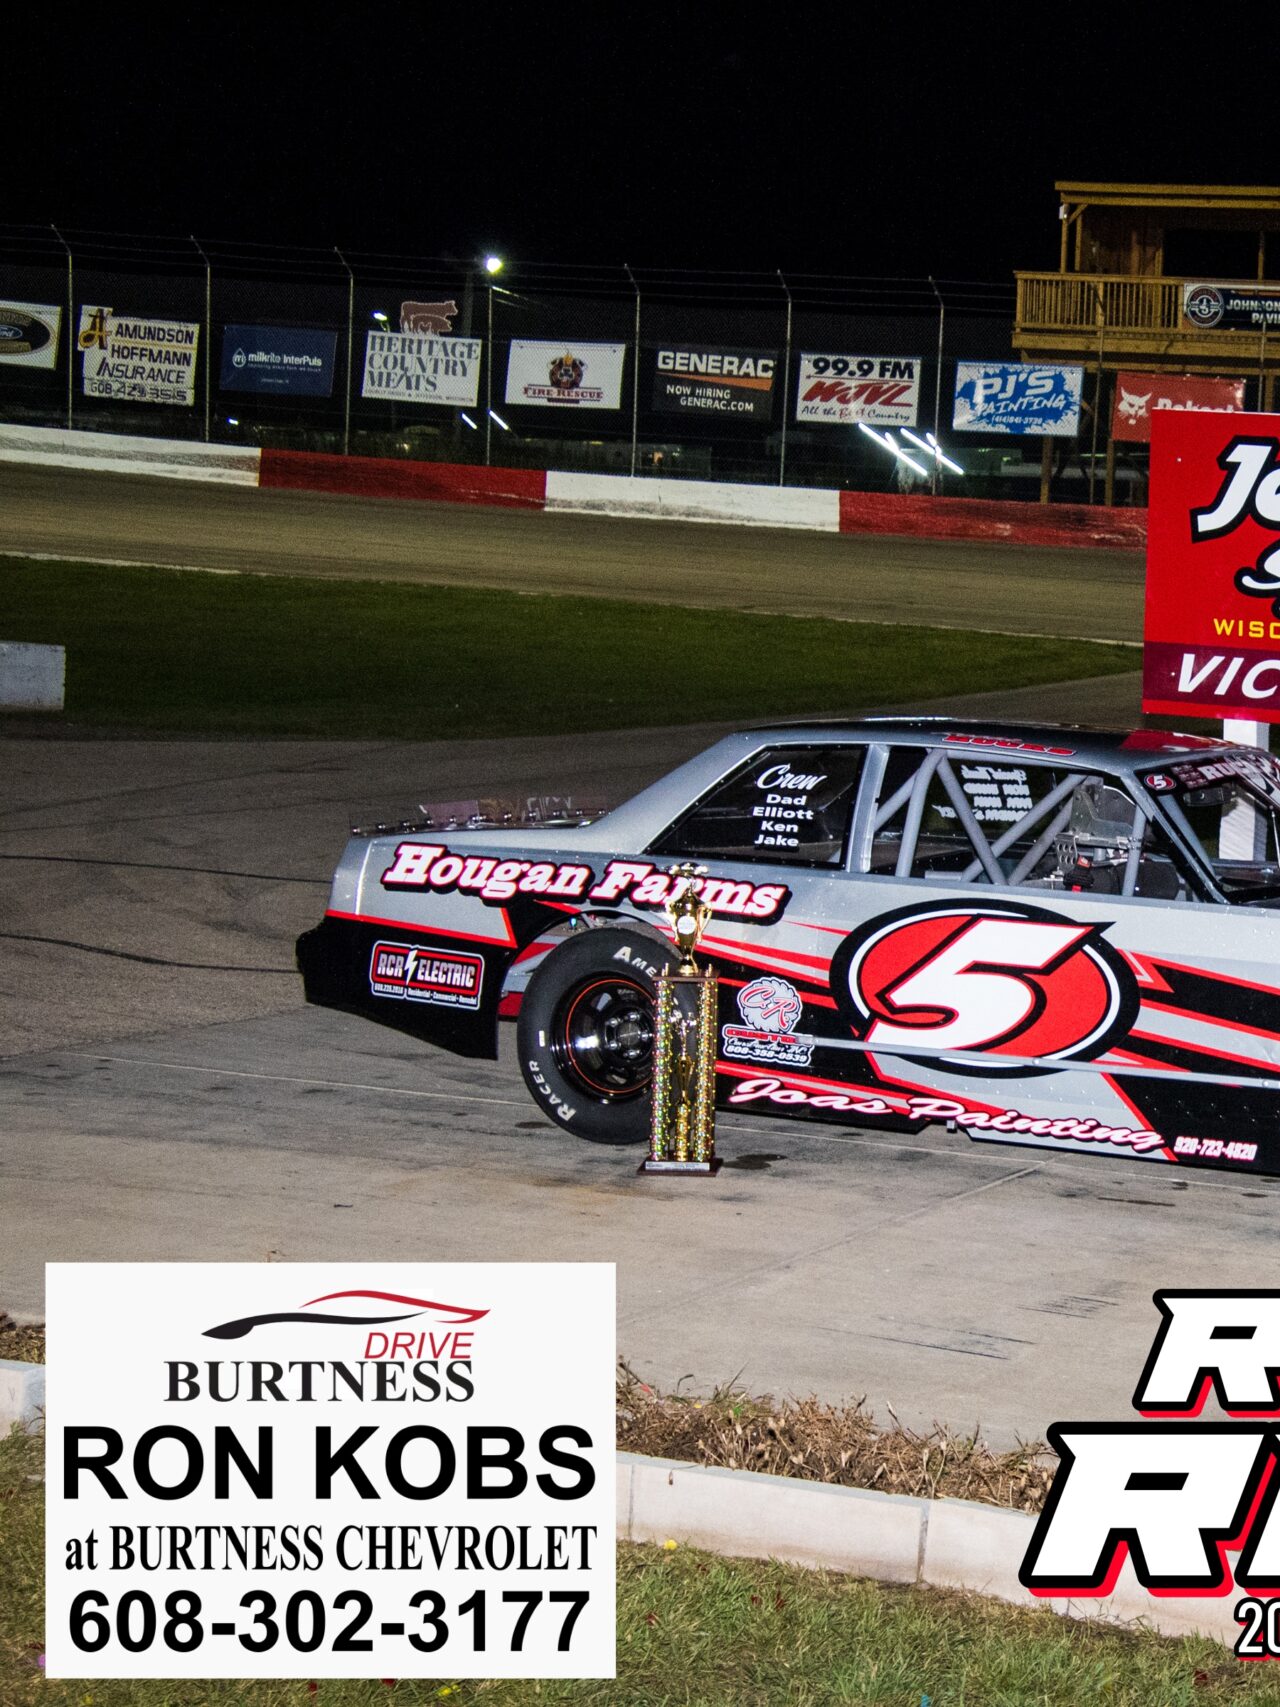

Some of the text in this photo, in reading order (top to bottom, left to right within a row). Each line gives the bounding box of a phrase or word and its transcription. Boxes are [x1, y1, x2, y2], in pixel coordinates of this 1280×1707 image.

[115, 322, 195, 345] AMUNDSON
[111, 343, 192, 367] HOFFMANN
[370, 334, 480, 360] HERITAGE
[96, 356, 186, 385] INSURANCE
[368, 352, 468, 378] COUNTRY
[656, 350, 774, 378] GENERAC
[812, 356, 915, 380] 99.9 FM
[367, 369, 438, 392] MEATS
[665, 384, 731, 399] NOW HIRING
[972, 370, 1055, 403] PJ'S
[556, 388, 604, 399] RESCUE
[679, 396, 755, 412] GENERAC.COM
[977, 392, 1067, 417] PAINTING
[801, 405, 820, 416] All
[867, 409, 911, 422] Country
[756, 762, 828, 791] Crew
[765, 793, 808, 806] Dad
[751, 805, 815, 821] Elliott
[760, 819, 800, 833] Ken
[754, 834, 800, 847] Jake
[382, 842, 788, 918] Hougan Farms
[377, 952, 476, 989] RCR ELECTRIC
[864, 916, 1096, 1052] 5
[726, 1045, 808, 1063] 608-358-0539
[528, 1060, 577, 1122] RACER
[907, 1096, 1165, 1151] Painting
